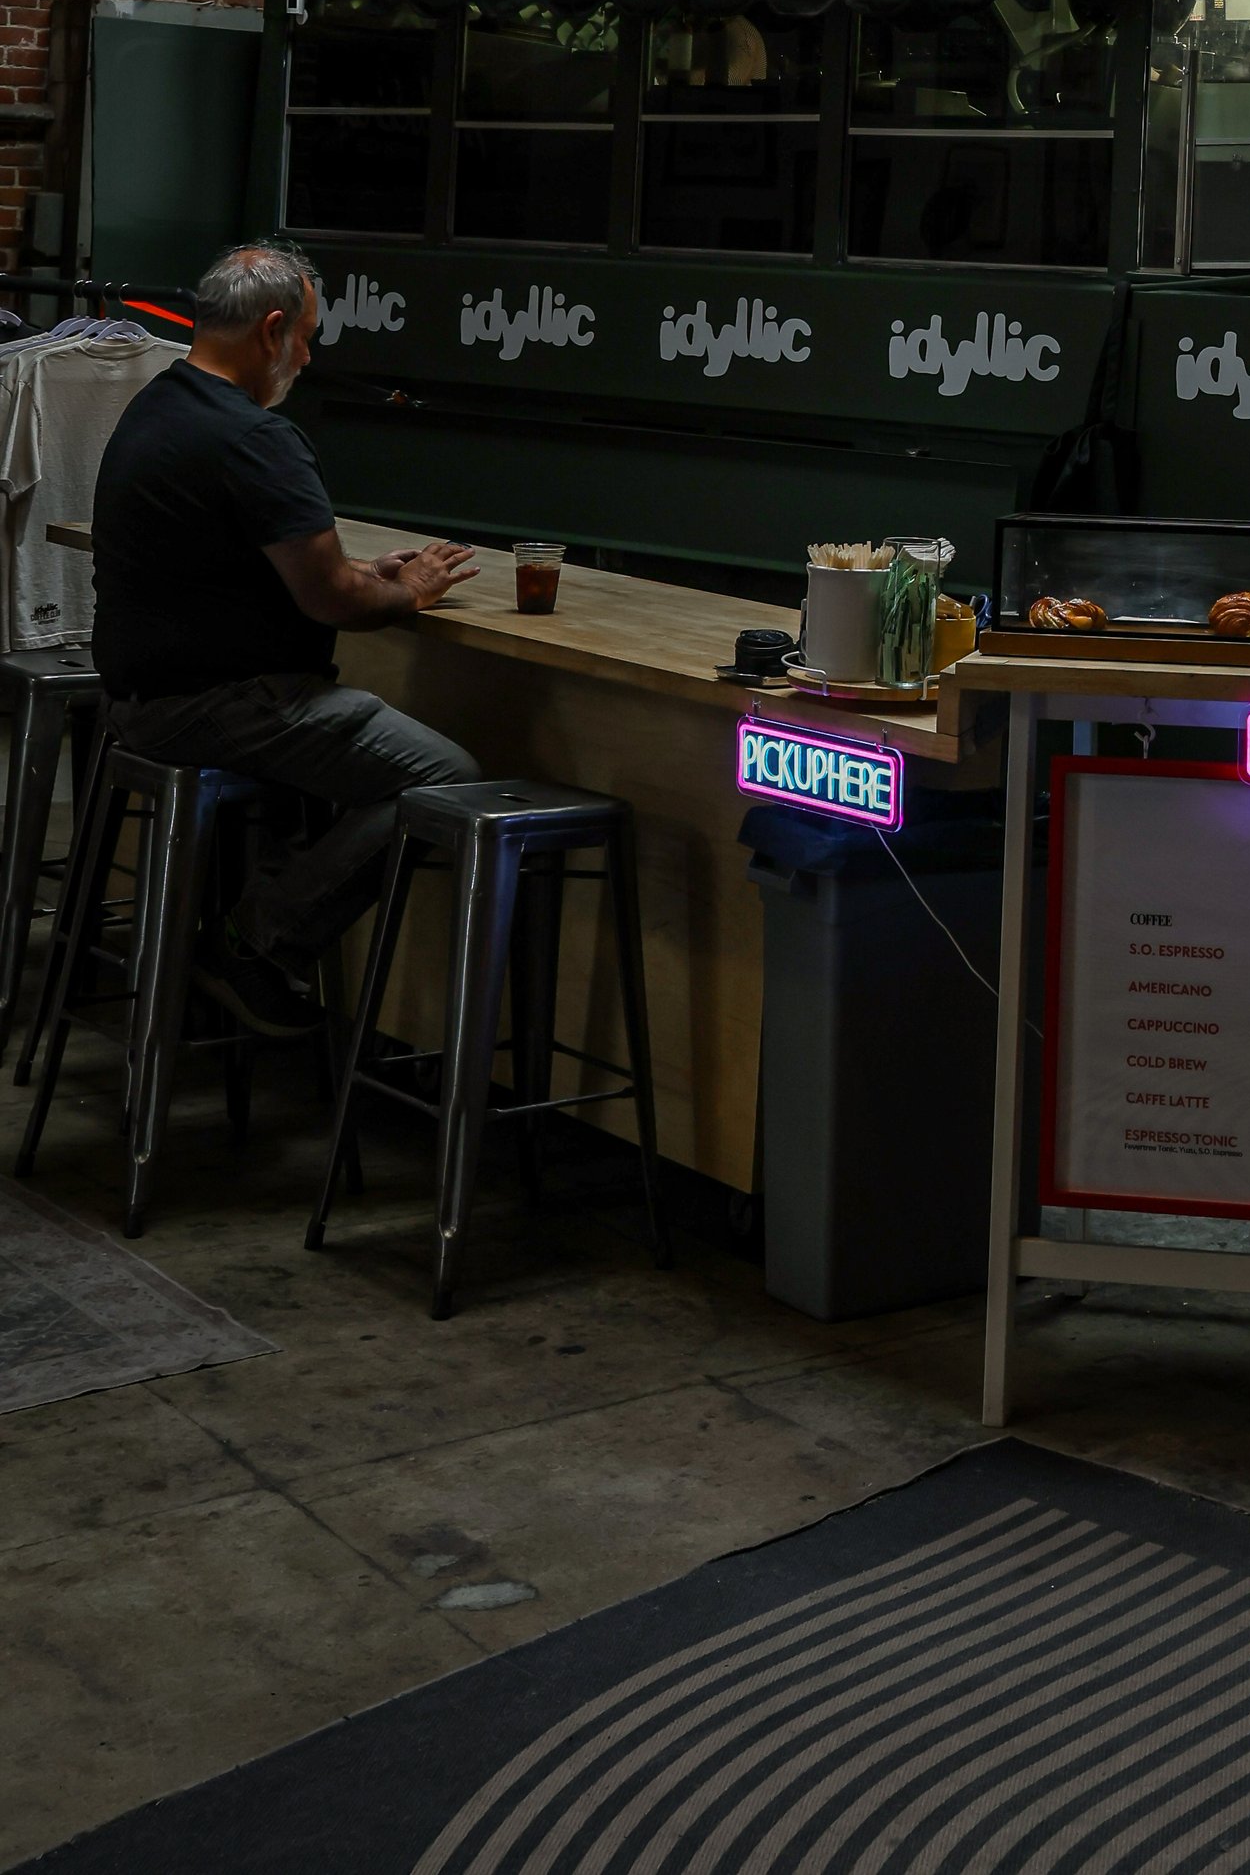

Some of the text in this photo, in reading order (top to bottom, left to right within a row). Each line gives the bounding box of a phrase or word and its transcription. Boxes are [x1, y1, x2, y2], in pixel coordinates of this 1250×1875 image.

[314, 274, 406, 346] yllic
[460, 285, 595, 361] idyllic
[660, 297, 812, 377] idyllic
[888, 311, 1061, 396] idyllic
[1130, 913, 1172, 927] COFFEE
[1129, 943, 1224, 959] S.O. ESPRESSO
[1129, 981, 1212, 997] AMERICANO
[1127, 1018, 1220, 1035] CAPPUCCINO
[1126, 1055, 1207, 1071] COLD BREW
[1126, 1092, 1210, 1109] CAFFE LATTE
[1125, 1129, 1238, 1148] ESPRESSO TONIC
